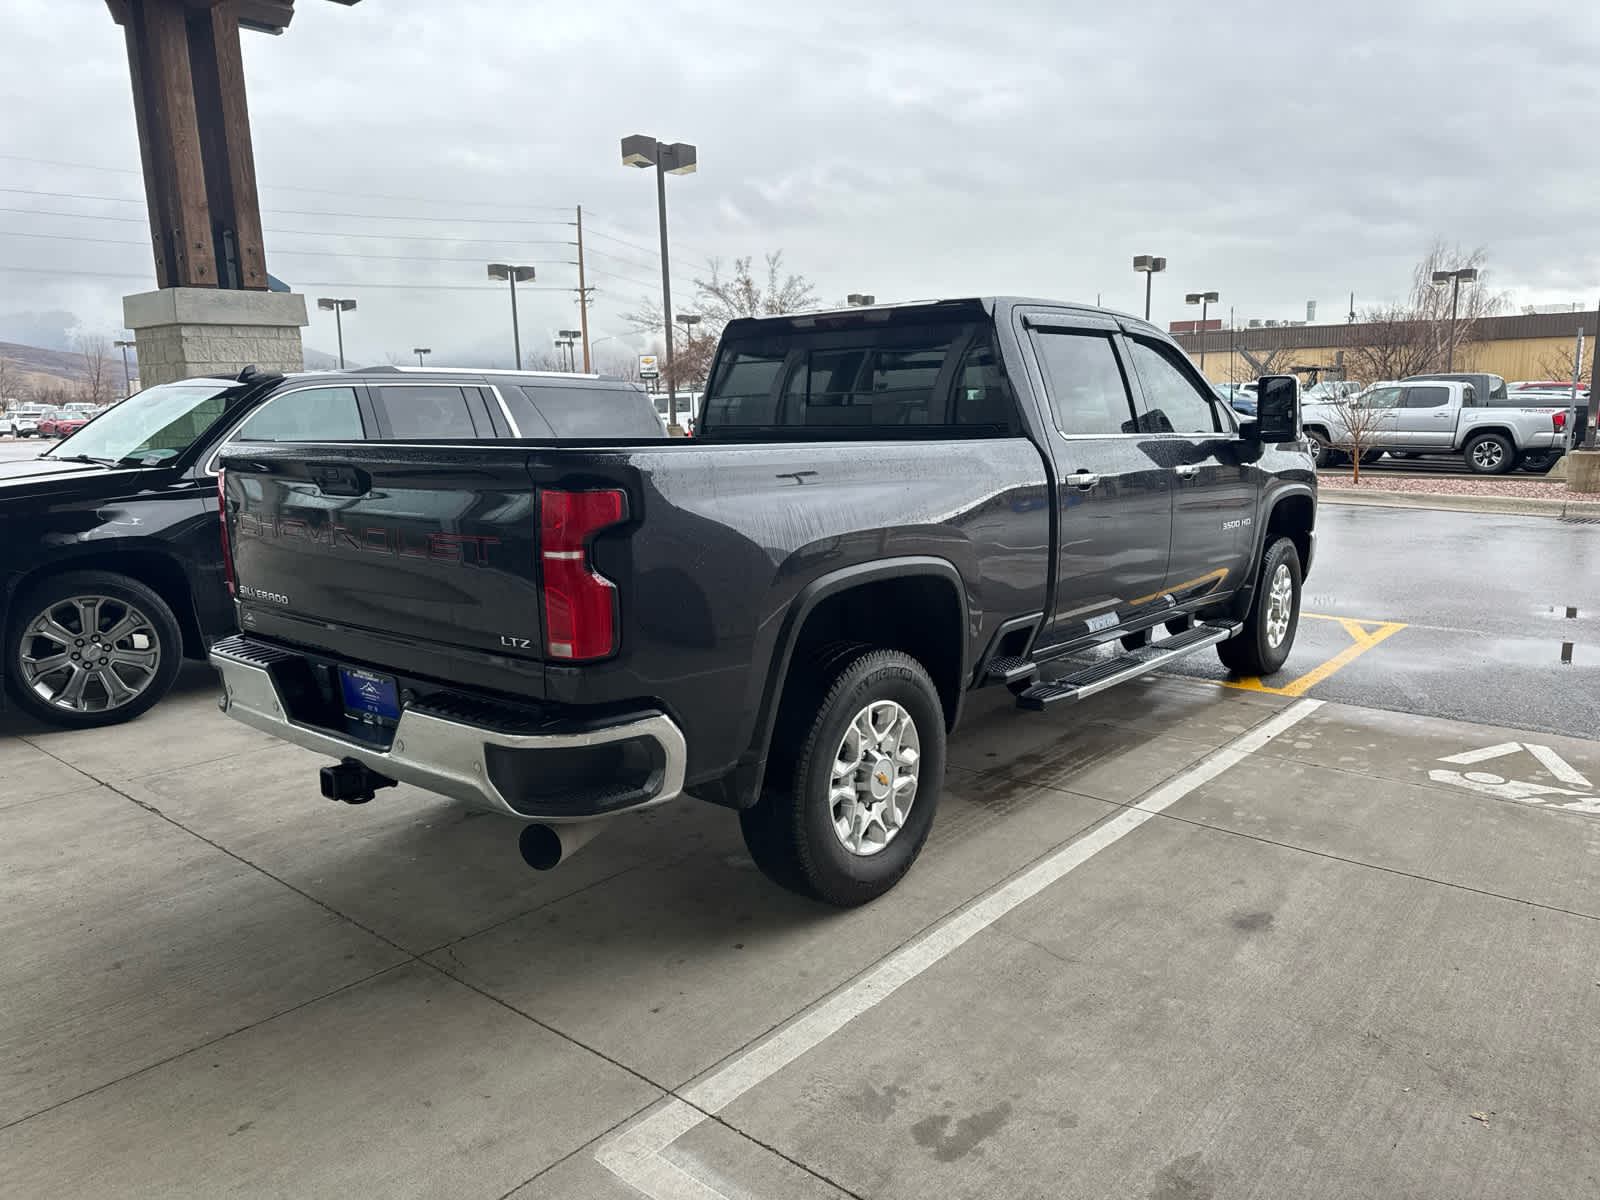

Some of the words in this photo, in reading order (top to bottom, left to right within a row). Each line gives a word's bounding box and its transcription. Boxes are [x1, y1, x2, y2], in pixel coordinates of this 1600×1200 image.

[238, 511, 500, 563] CHEVROLET
[239, 585, 289, 605] SILVERADO
[500, 635, 531, 649] LTZ
